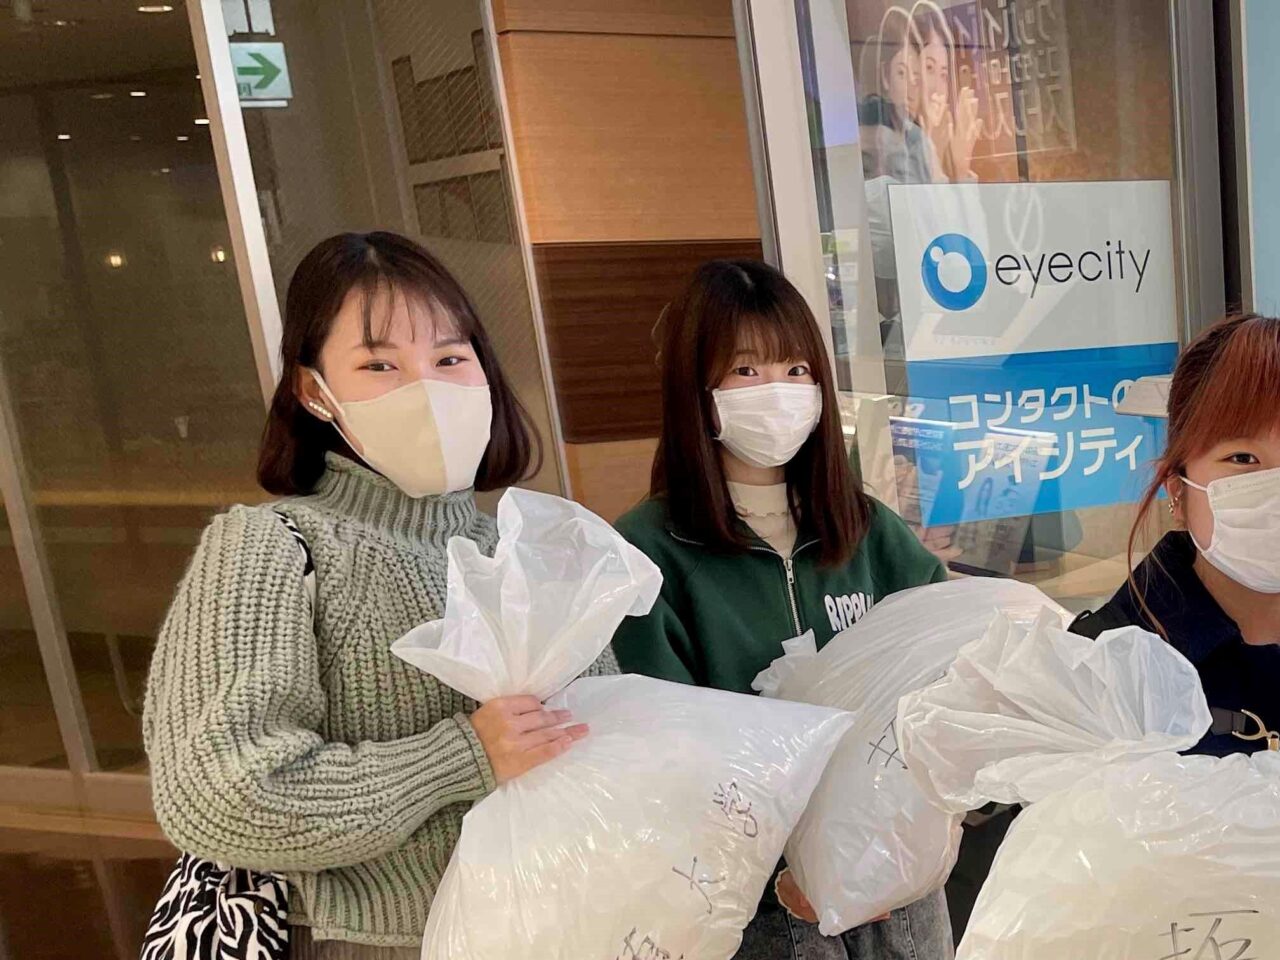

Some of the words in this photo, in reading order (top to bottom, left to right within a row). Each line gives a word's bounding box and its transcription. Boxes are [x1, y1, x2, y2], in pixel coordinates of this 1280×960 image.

[995, 240, 1151, 299] eyecity
[954, 427, 1144, 490] アイシティ
